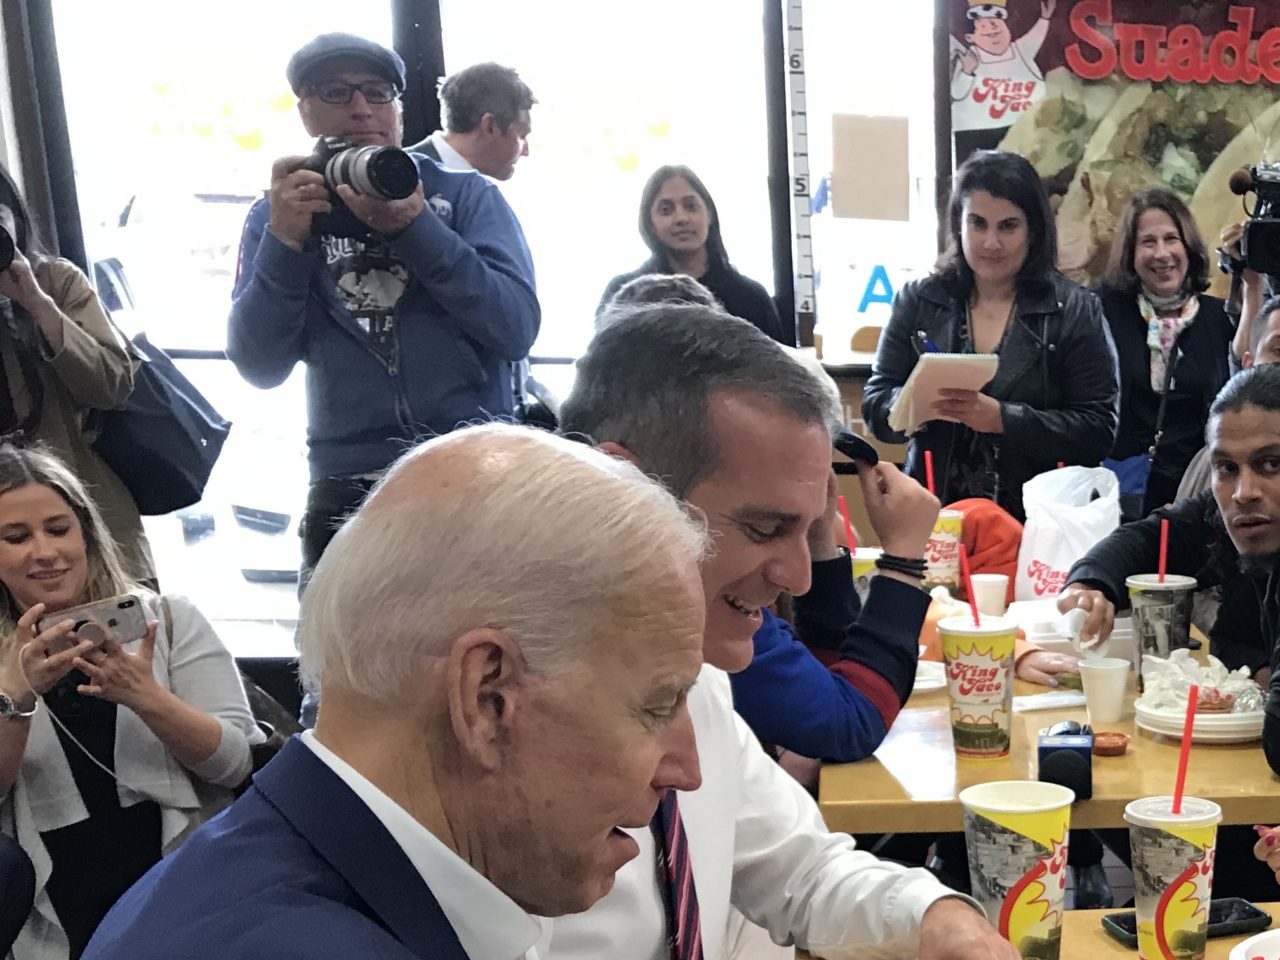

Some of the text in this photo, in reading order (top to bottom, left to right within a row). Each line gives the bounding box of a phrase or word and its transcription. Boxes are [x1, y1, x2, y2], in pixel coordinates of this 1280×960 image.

[789, 54, 801, 69] 6
[972, 77, 1037, 103] King
[989, 95, 1032, 119] Tac
[794, 177, 806, 193] 5
[857, 265, 893, 312] A
[950, 662, 999, 682] King
[959, 678, 1002, 695] Taco
